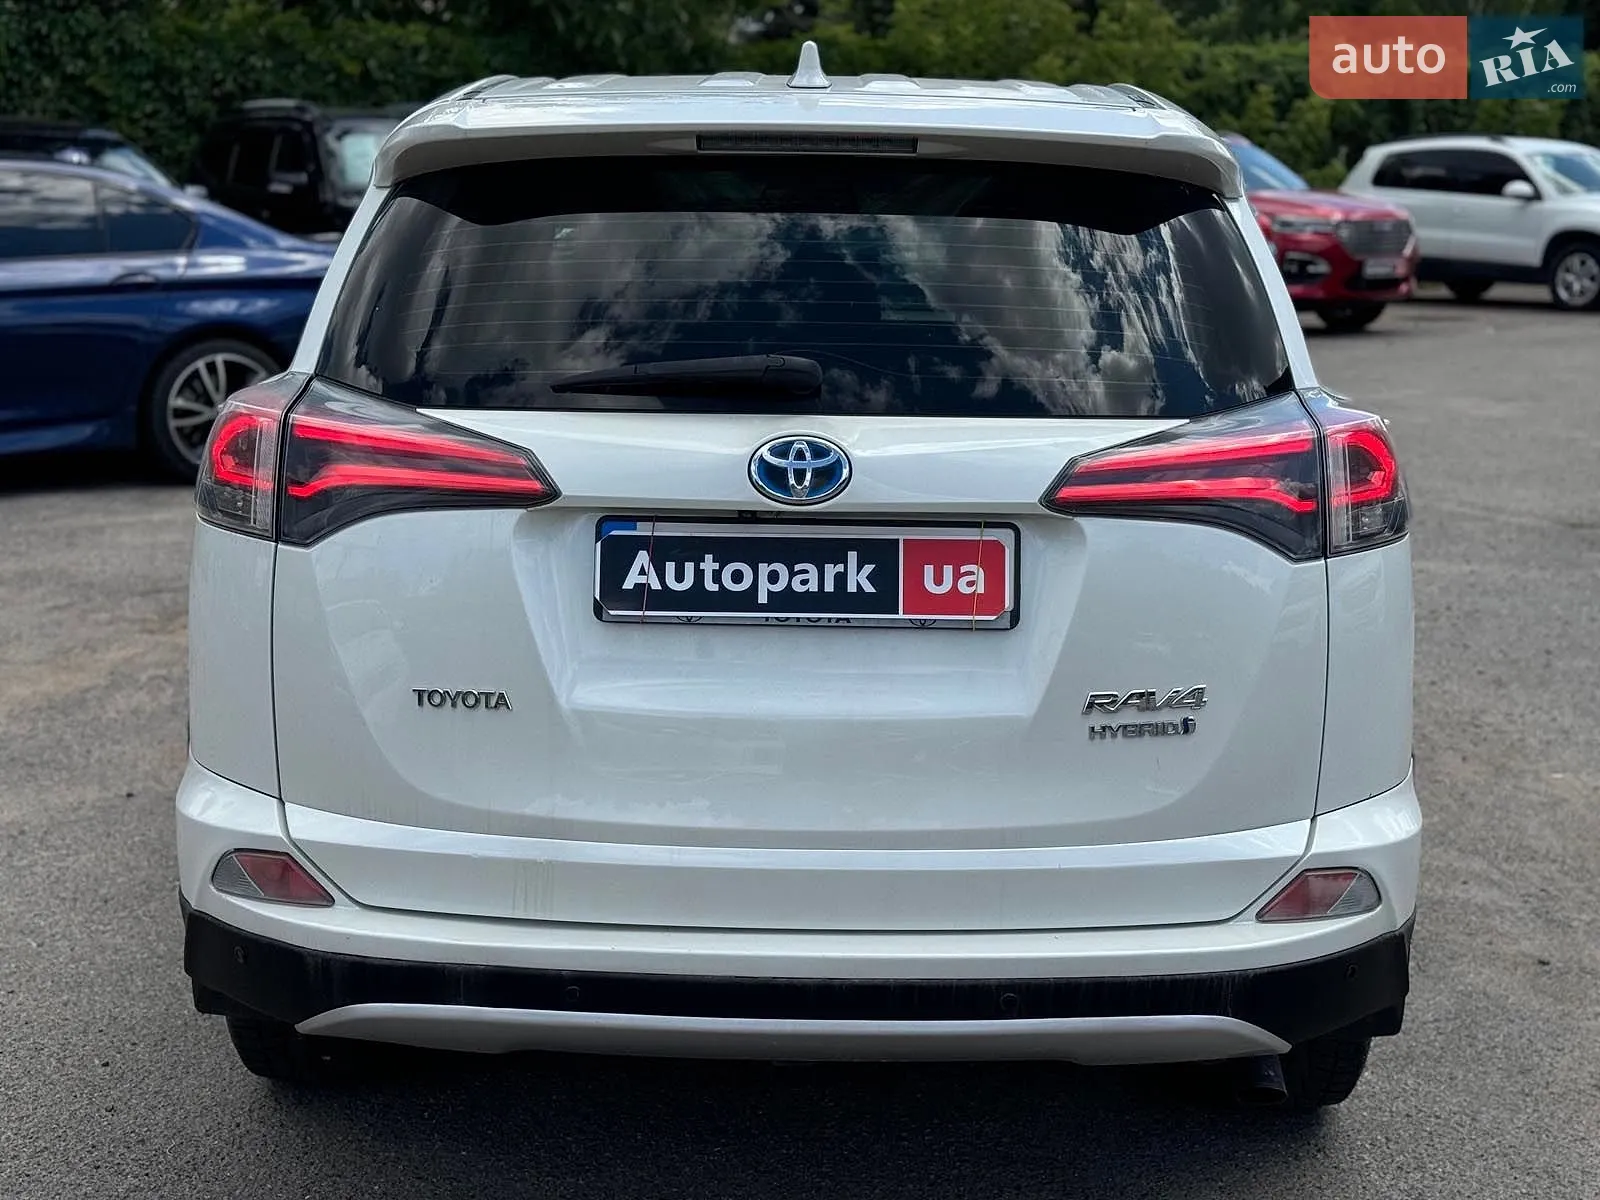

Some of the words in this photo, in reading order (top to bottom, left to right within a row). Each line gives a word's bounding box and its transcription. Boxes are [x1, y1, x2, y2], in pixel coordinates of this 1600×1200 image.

[622, 550, 876, 604] Autopark
[923, 564, 985, 595] ua
[412, 688, 512, 711] TOYOTA
[1082, 684, 1208, 715] RAV4
[1088, 720, 1180, 740] HYBRID
